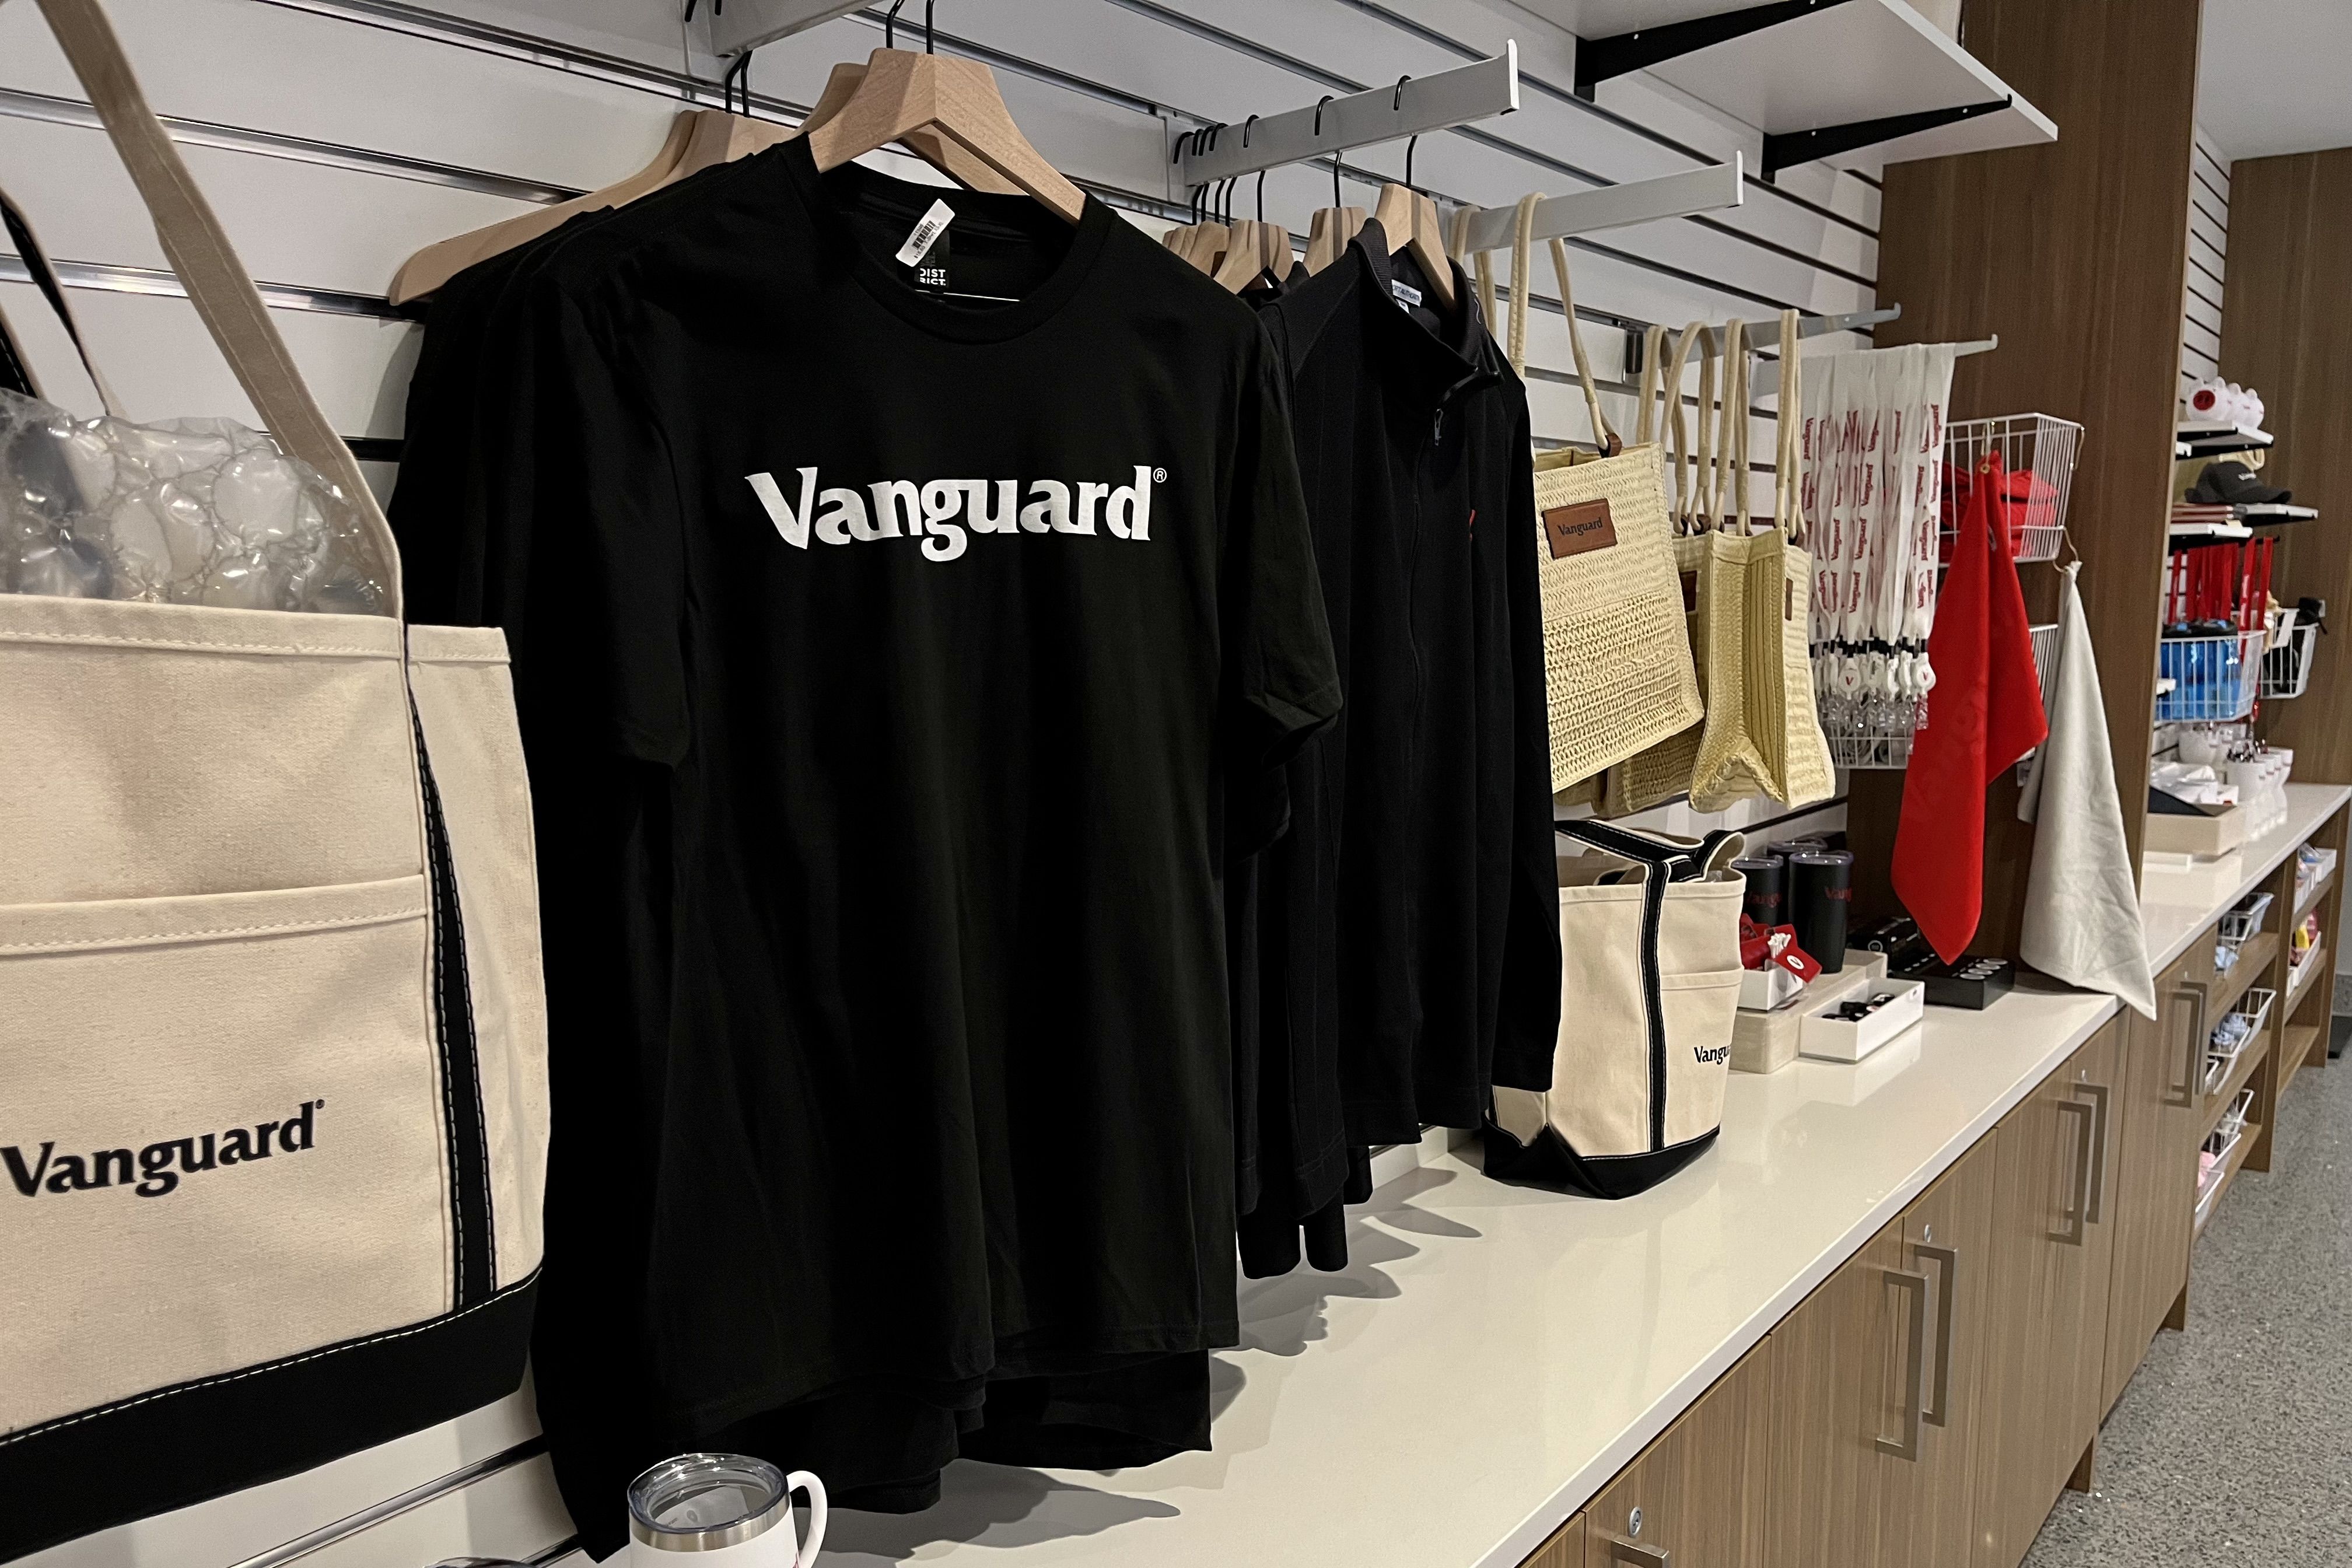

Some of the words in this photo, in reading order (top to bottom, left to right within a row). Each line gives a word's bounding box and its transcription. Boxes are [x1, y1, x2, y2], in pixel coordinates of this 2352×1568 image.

[1558, 517, 1603, 536] Vanguard
[1845, 676, 1854, 686] V
[1693, 1045, 1731, 1065] Vangu
